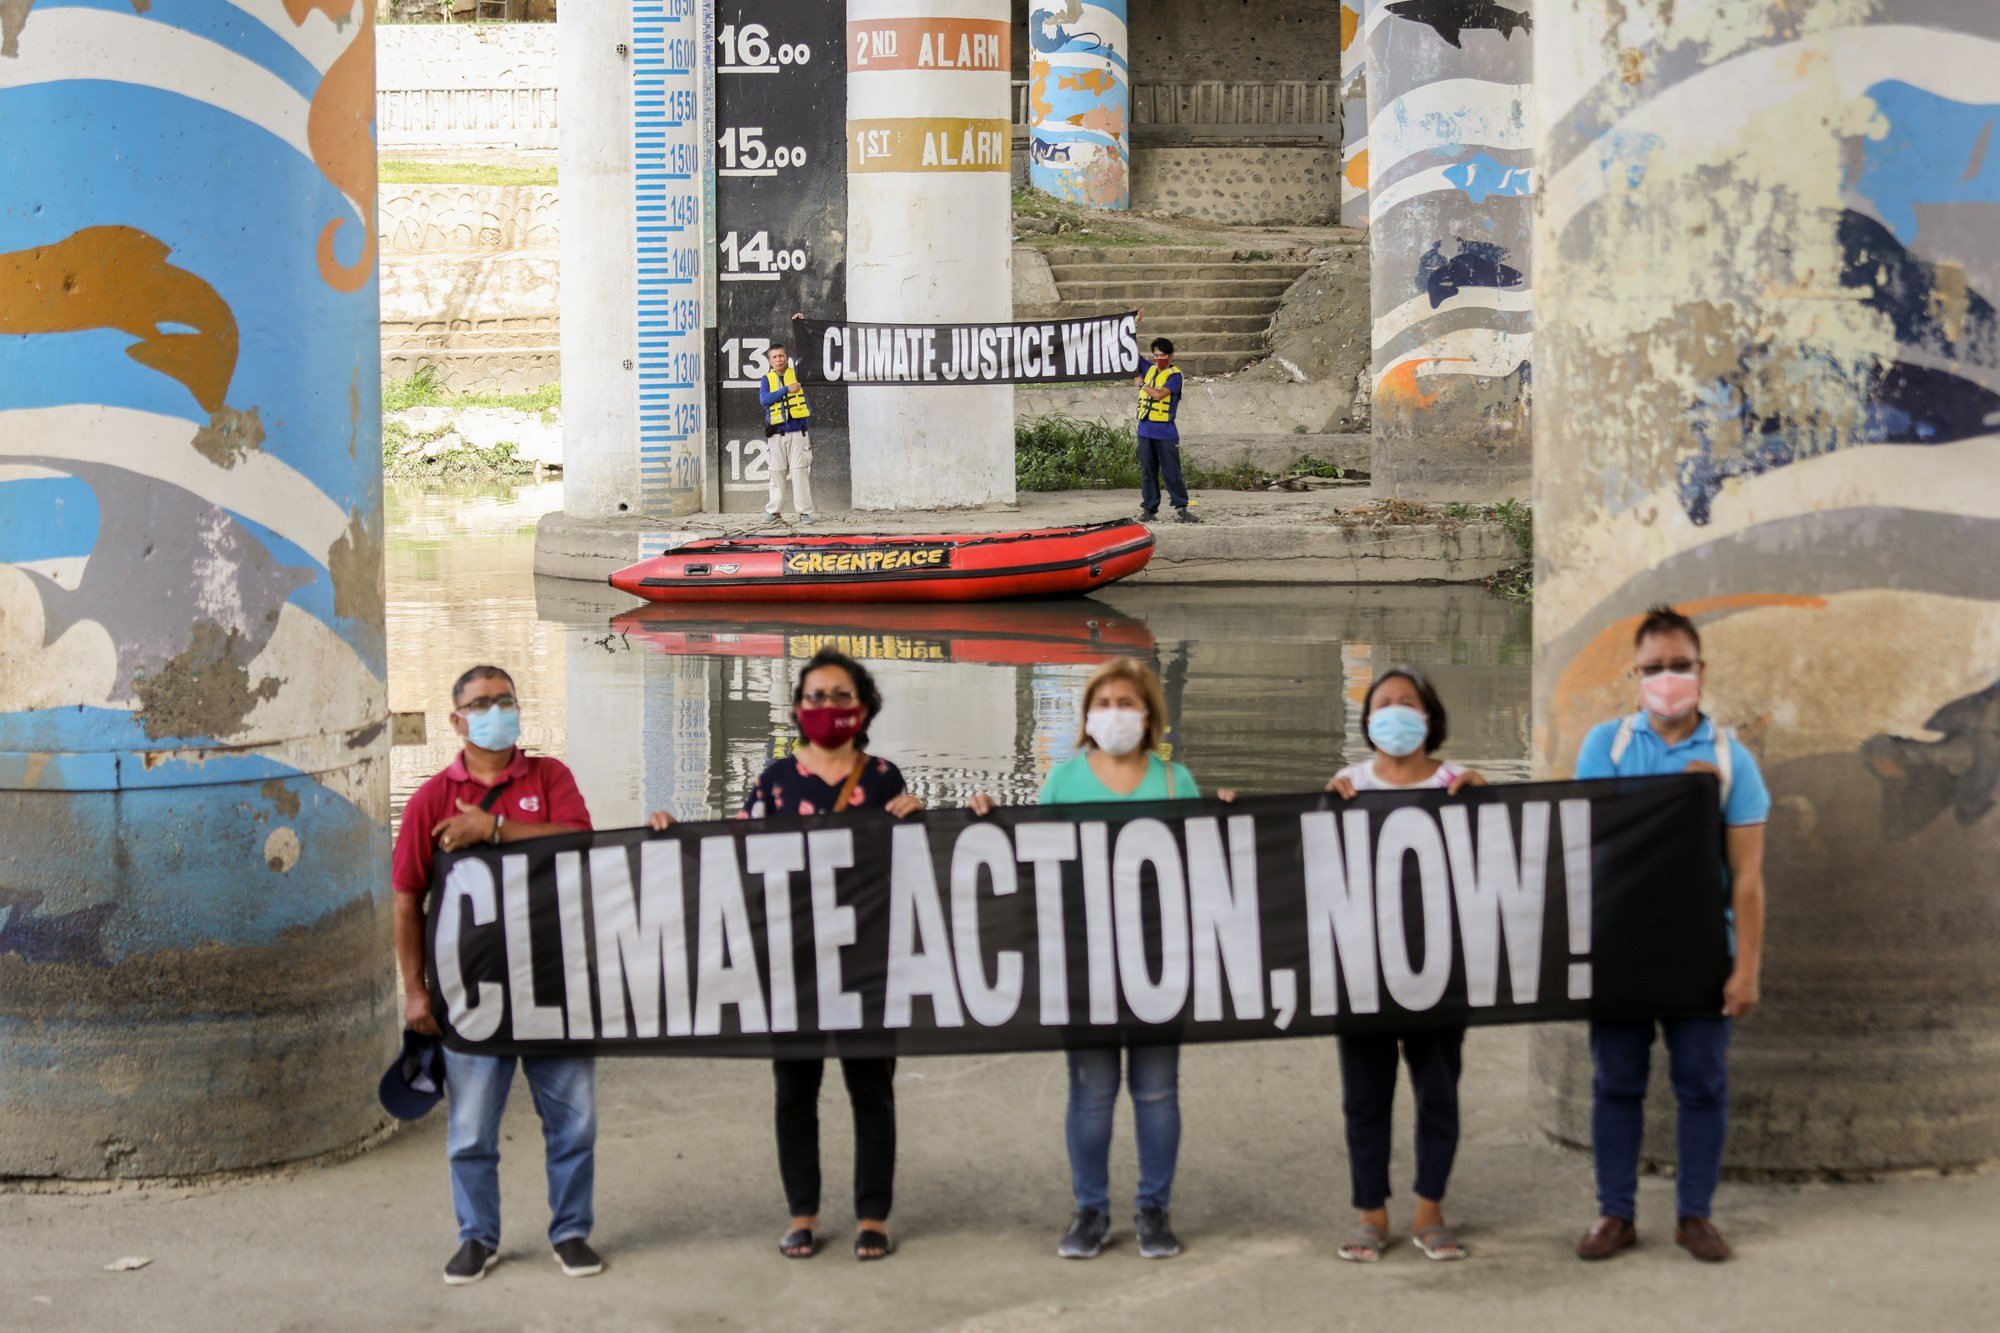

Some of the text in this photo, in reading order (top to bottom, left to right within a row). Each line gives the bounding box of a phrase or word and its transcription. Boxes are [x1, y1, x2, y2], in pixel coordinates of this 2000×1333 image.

[718, 24, 810, 65] 16.00
[856, 30, 999, 68] 2ND ALARM
[718, 127, 807, 169] 15.00
[856, 130, 1002, 167] 1ST ALARM
[720, 231, 806, 272] 14.00
[823, 315, 1139, 382] CLIMATE JUSTICE WINS
[788, 549, 944, 574] GREENPEACE
[434, 799, 1593, 1042] CLIMATE ACTION, NOW!
